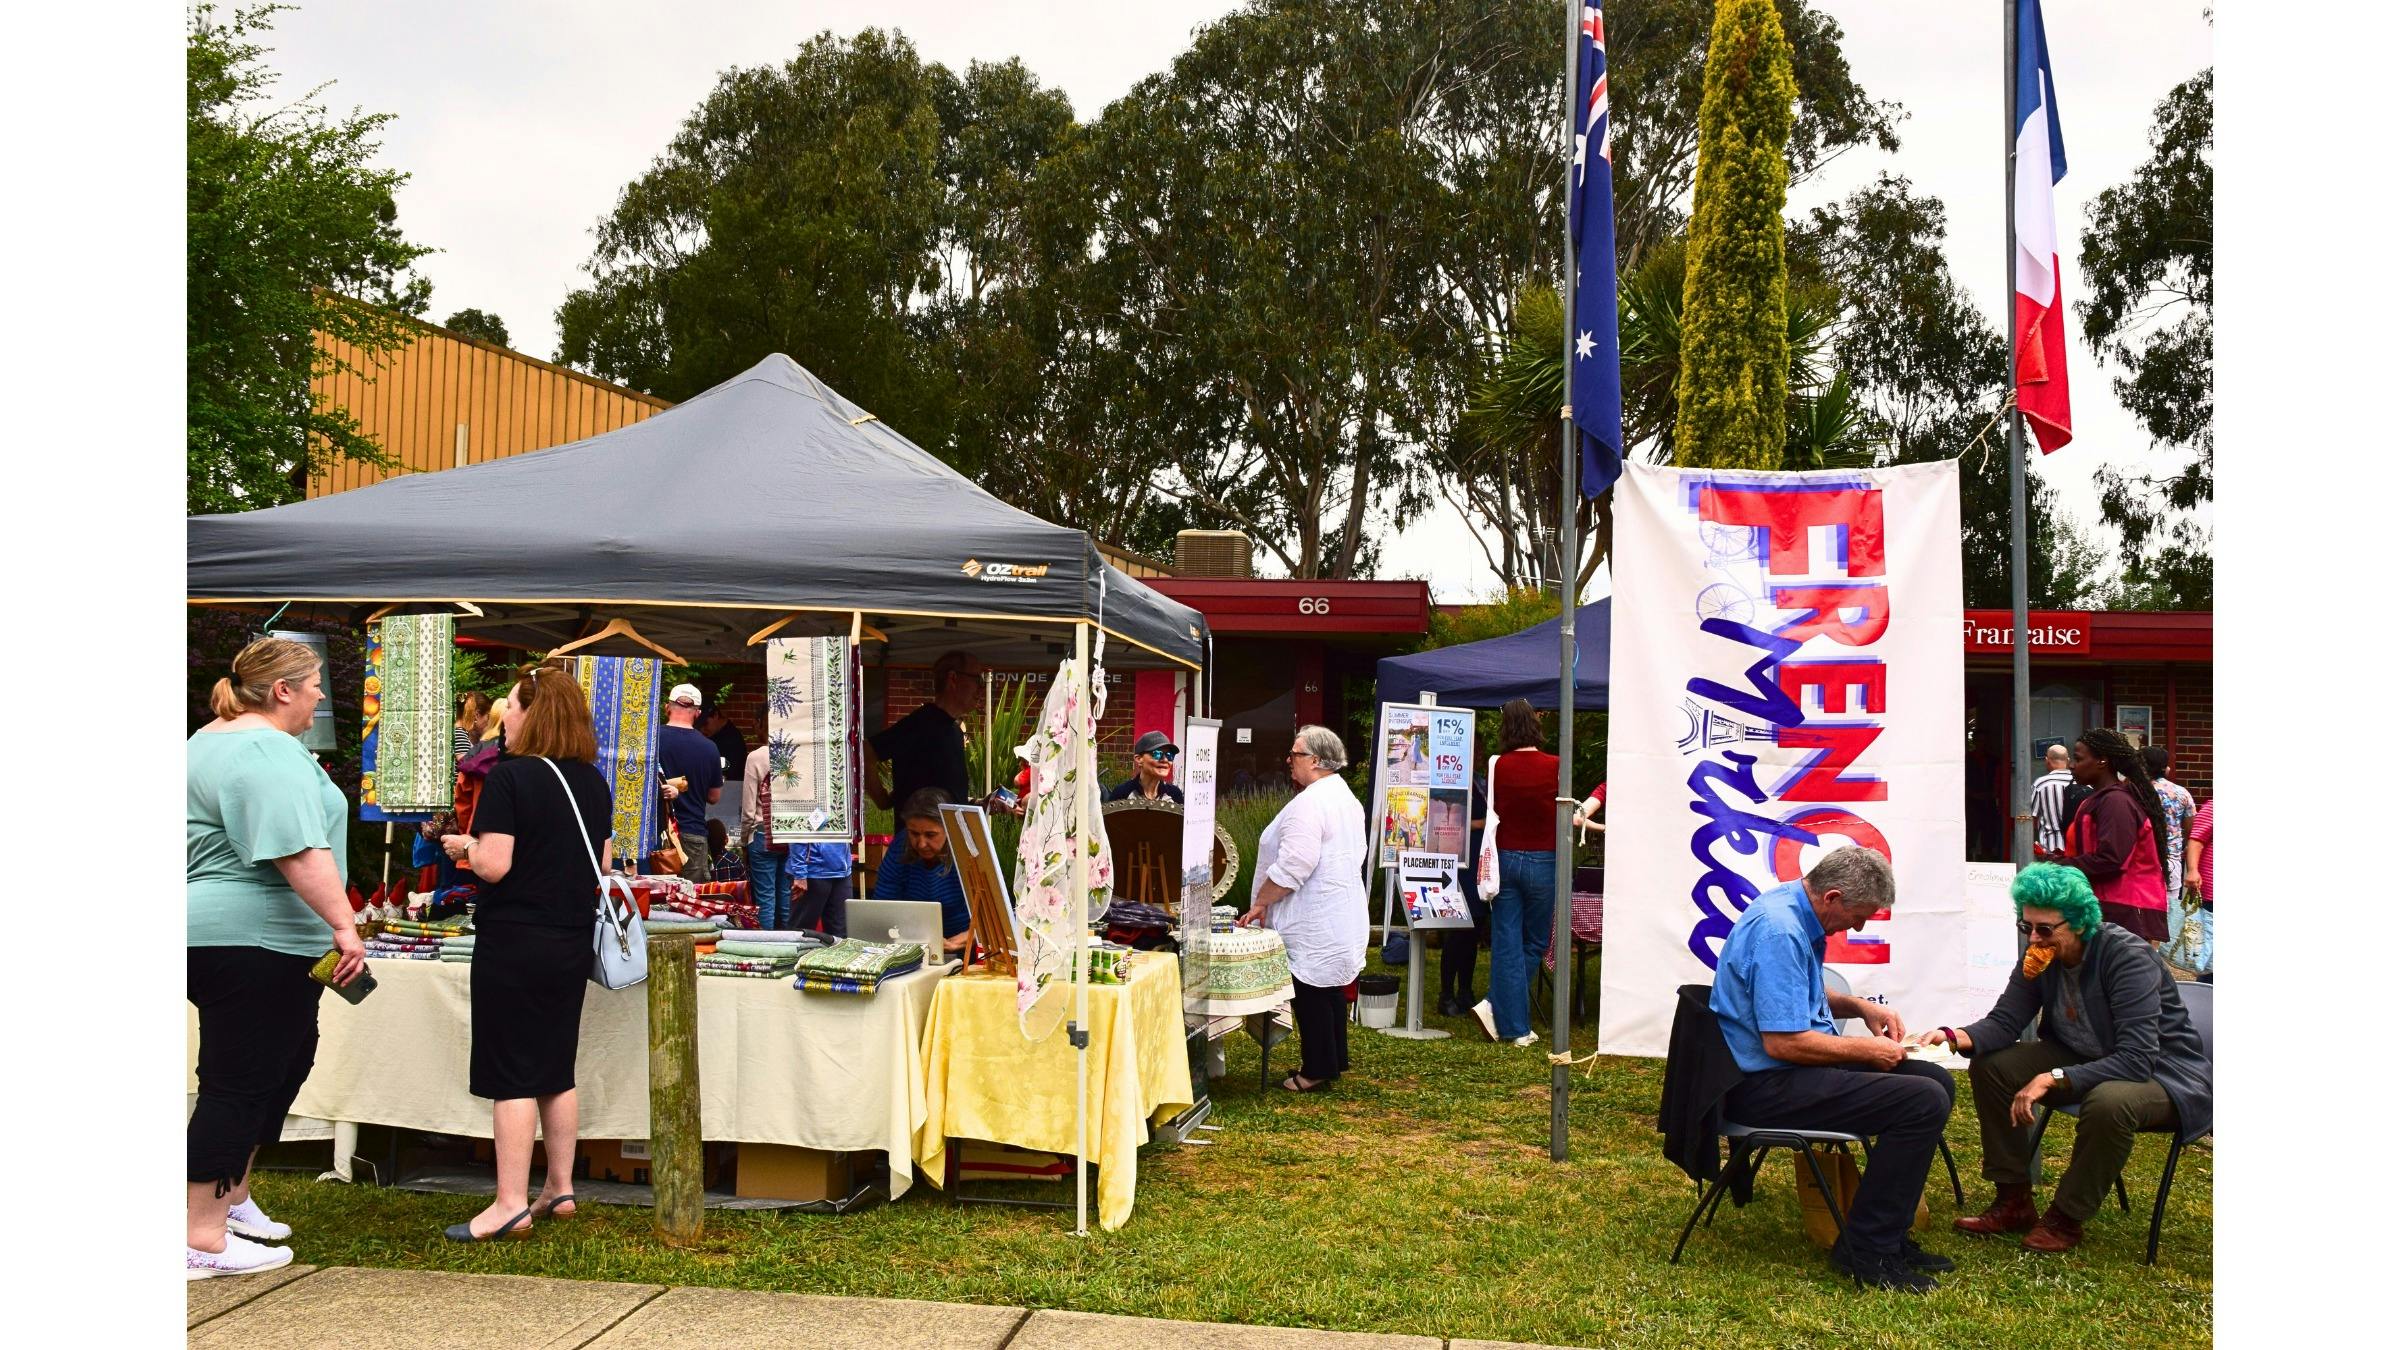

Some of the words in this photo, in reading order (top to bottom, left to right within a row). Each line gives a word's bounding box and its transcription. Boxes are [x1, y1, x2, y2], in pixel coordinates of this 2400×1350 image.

[986, 563, 1048, 577] OZtrail
[1298, 597, 1330, 615] 66
[1027, 672, 1048, 683] DE
[1304, 679, 1318, 693] 66
[1436, 718, 1465, 735] 15%
[1195, 748, 1211, 762] HOME
[1436, 754, 1463, 772] 15%
[1192, 770, 1213, 784] FRENCH
[1194, 792, 1209, 806] HOME
[1403, 857, 1439, 869] PLACEMENT
[1440, 858, 1455, 870] TEST
